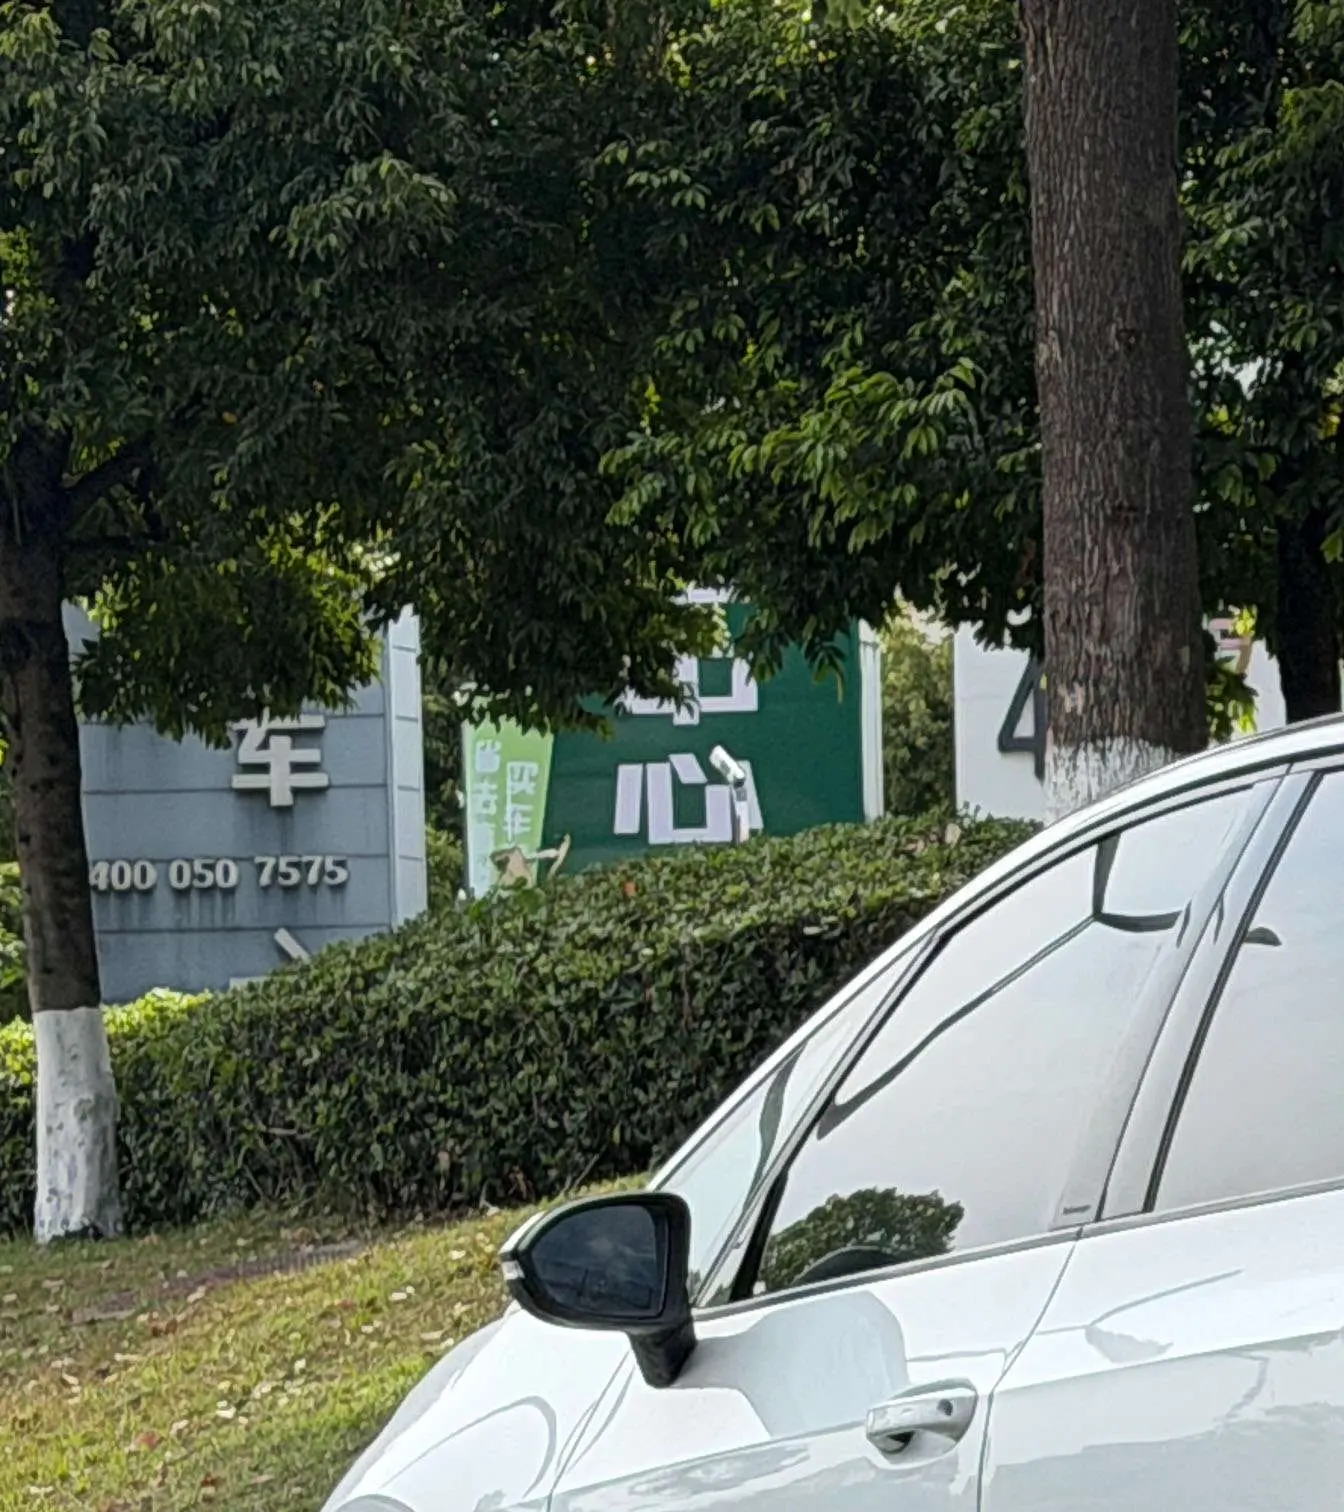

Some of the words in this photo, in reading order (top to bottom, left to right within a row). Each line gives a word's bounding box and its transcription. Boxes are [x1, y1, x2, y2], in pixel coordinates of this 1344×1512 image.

[90, 858, 158, 893] 400
[168, 857, 239, 891] 050
[254, 854, 350, 889] 7575
